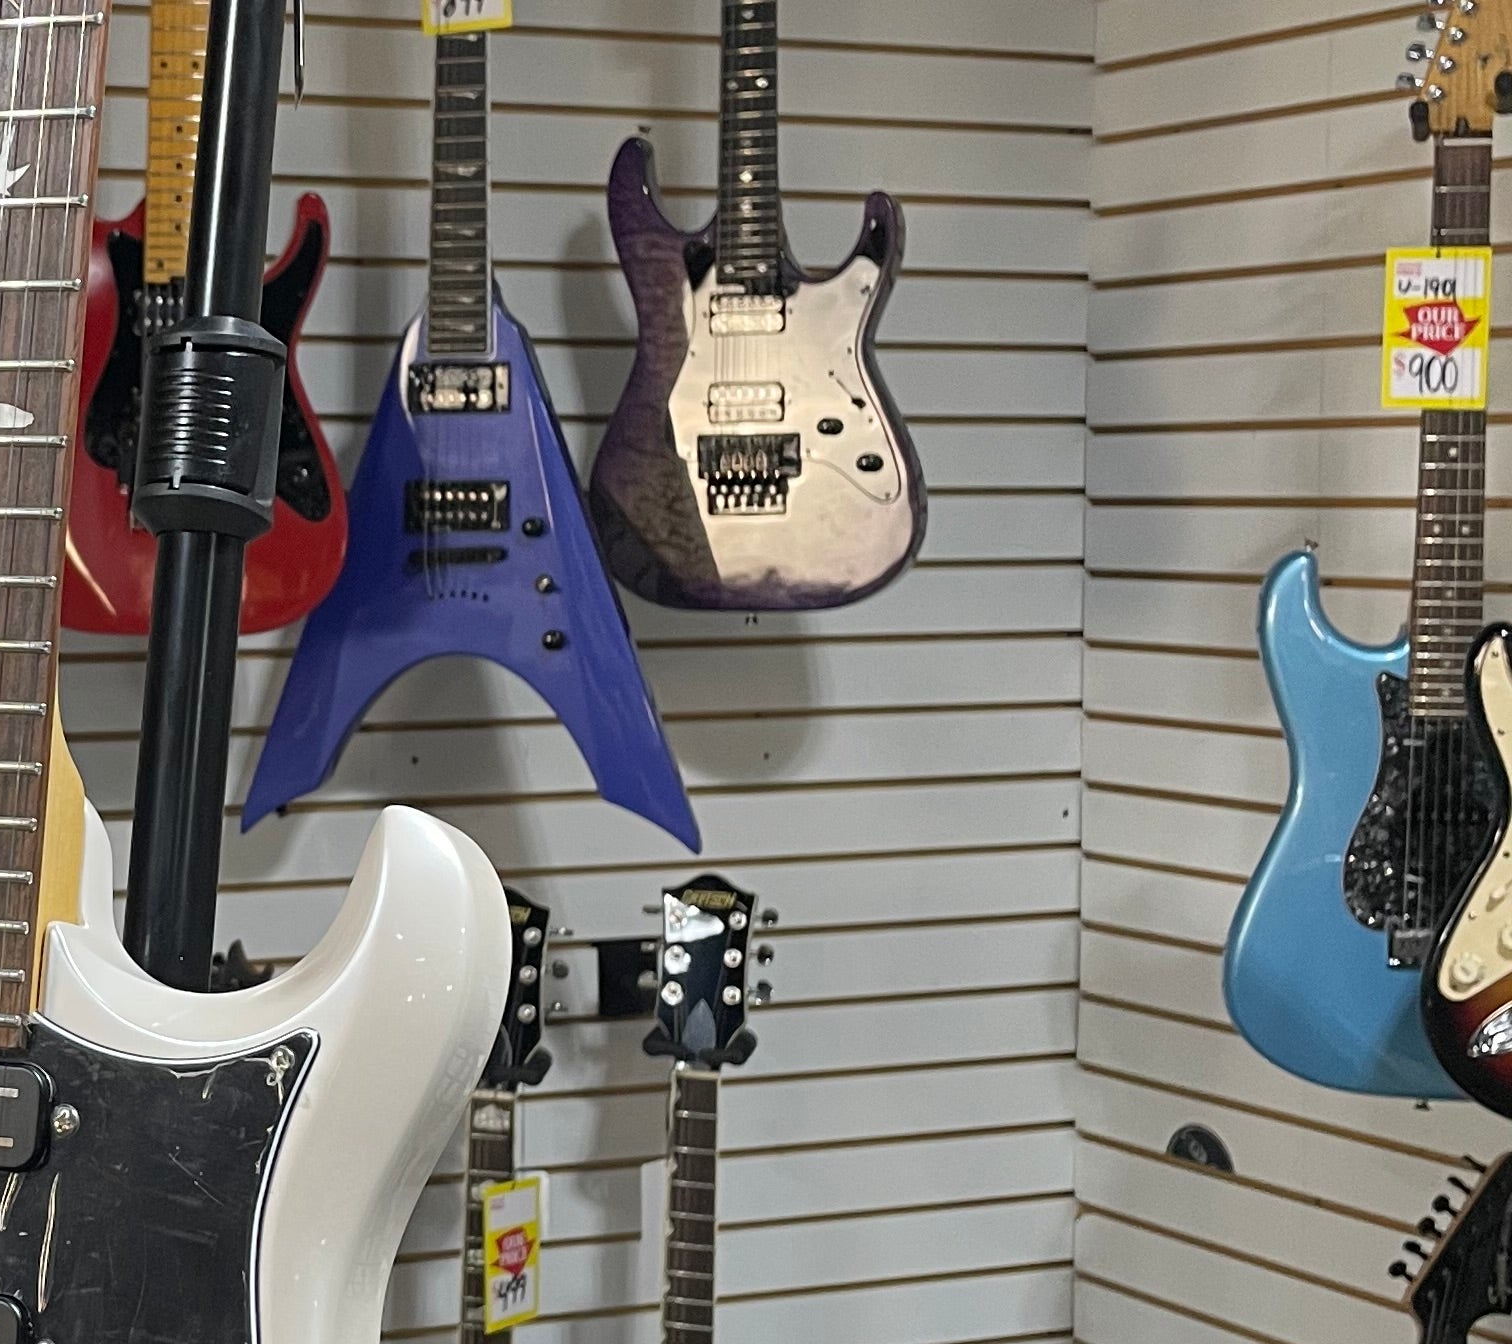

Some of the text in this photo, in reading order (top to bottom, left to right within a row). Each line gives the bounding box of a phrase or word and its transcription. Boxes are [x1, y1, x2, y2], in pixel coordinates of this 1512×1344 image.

[1417, 305, 1460, 324] OUR
[1410, 320, 1466, 342] PRICE
[1394, 352, 1459, 396] $900
